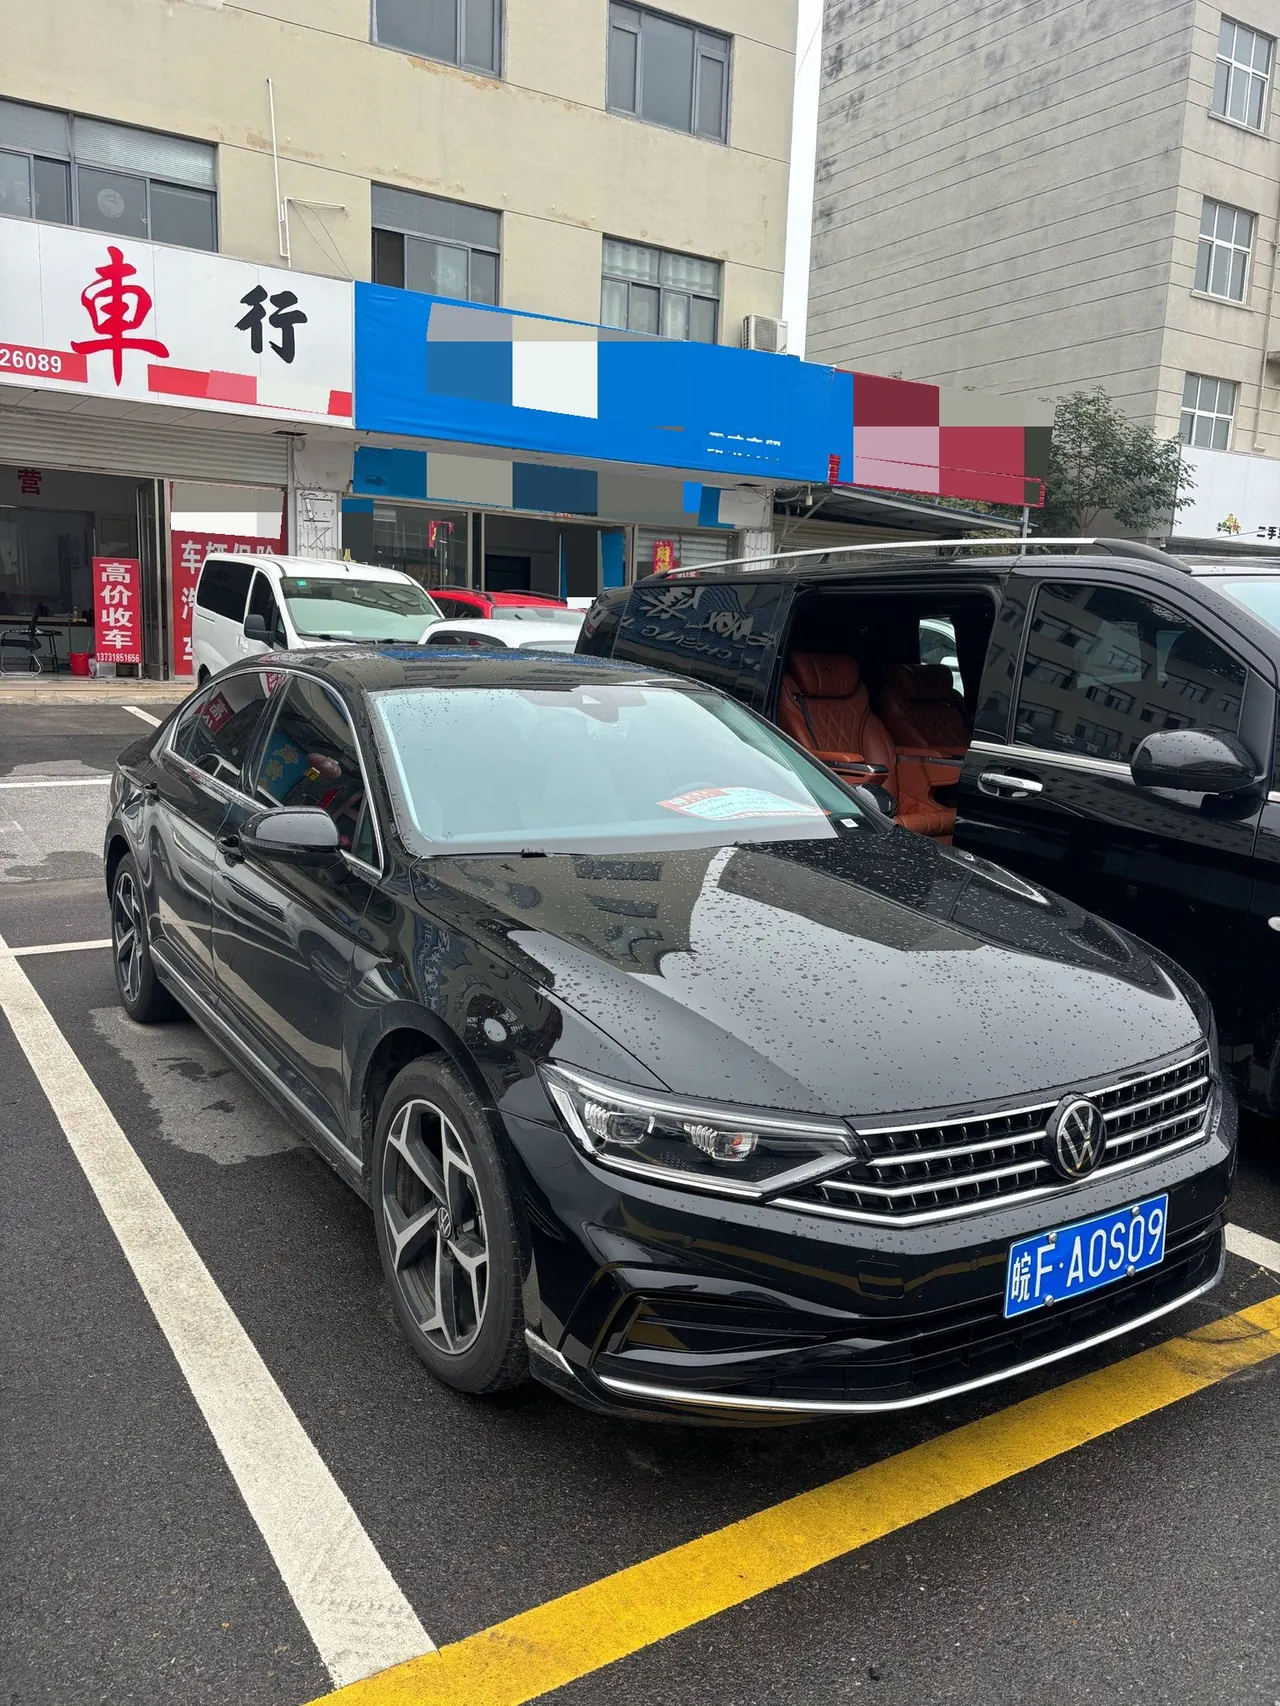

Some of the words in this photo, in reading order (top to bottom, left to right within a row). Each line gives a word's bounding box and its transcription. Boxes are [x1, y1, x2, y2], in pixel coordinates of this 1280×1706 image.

[0, 348, 62, 374] 26089
[1256, 525, 1280, 540] 二手
[99, 561, 134, 649] 高价收车
[96, 652, 140, 663] 13731851656
